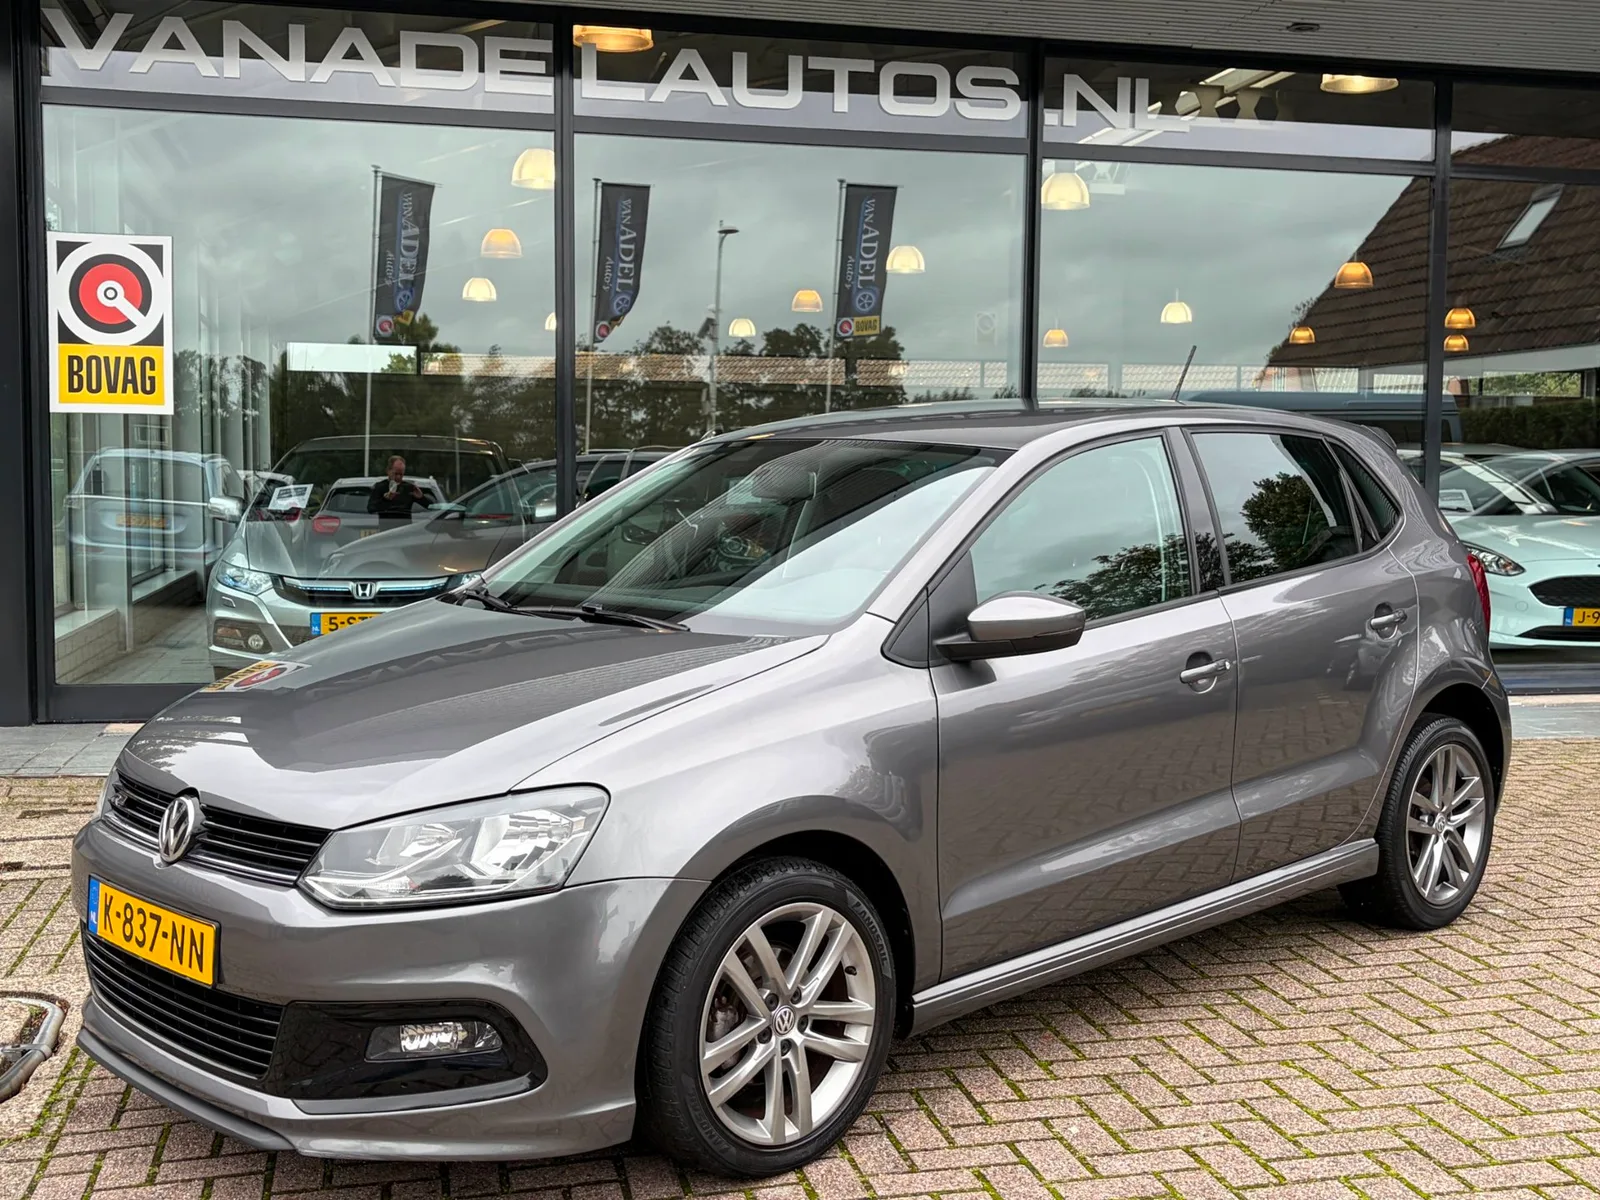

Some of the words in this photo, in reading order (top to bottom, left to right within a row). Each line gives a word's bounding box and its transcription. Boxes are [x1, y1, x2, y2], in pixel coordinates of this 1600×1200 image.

[620, 199, 632, 225] VAN
[864, 199, 876, 223] VAN
[399, 218, 420, 288] ADEL
[616, 226, 637, 292] ADEL
[857, 224, 880, 289] ADEL
[855, 318, 878, 333] BOVAG
[68, 355, 156, 395] BOVAG
[104, 892, 204, 973] K-837-NN
[851, 901, 888, 966] LANDSAIL
